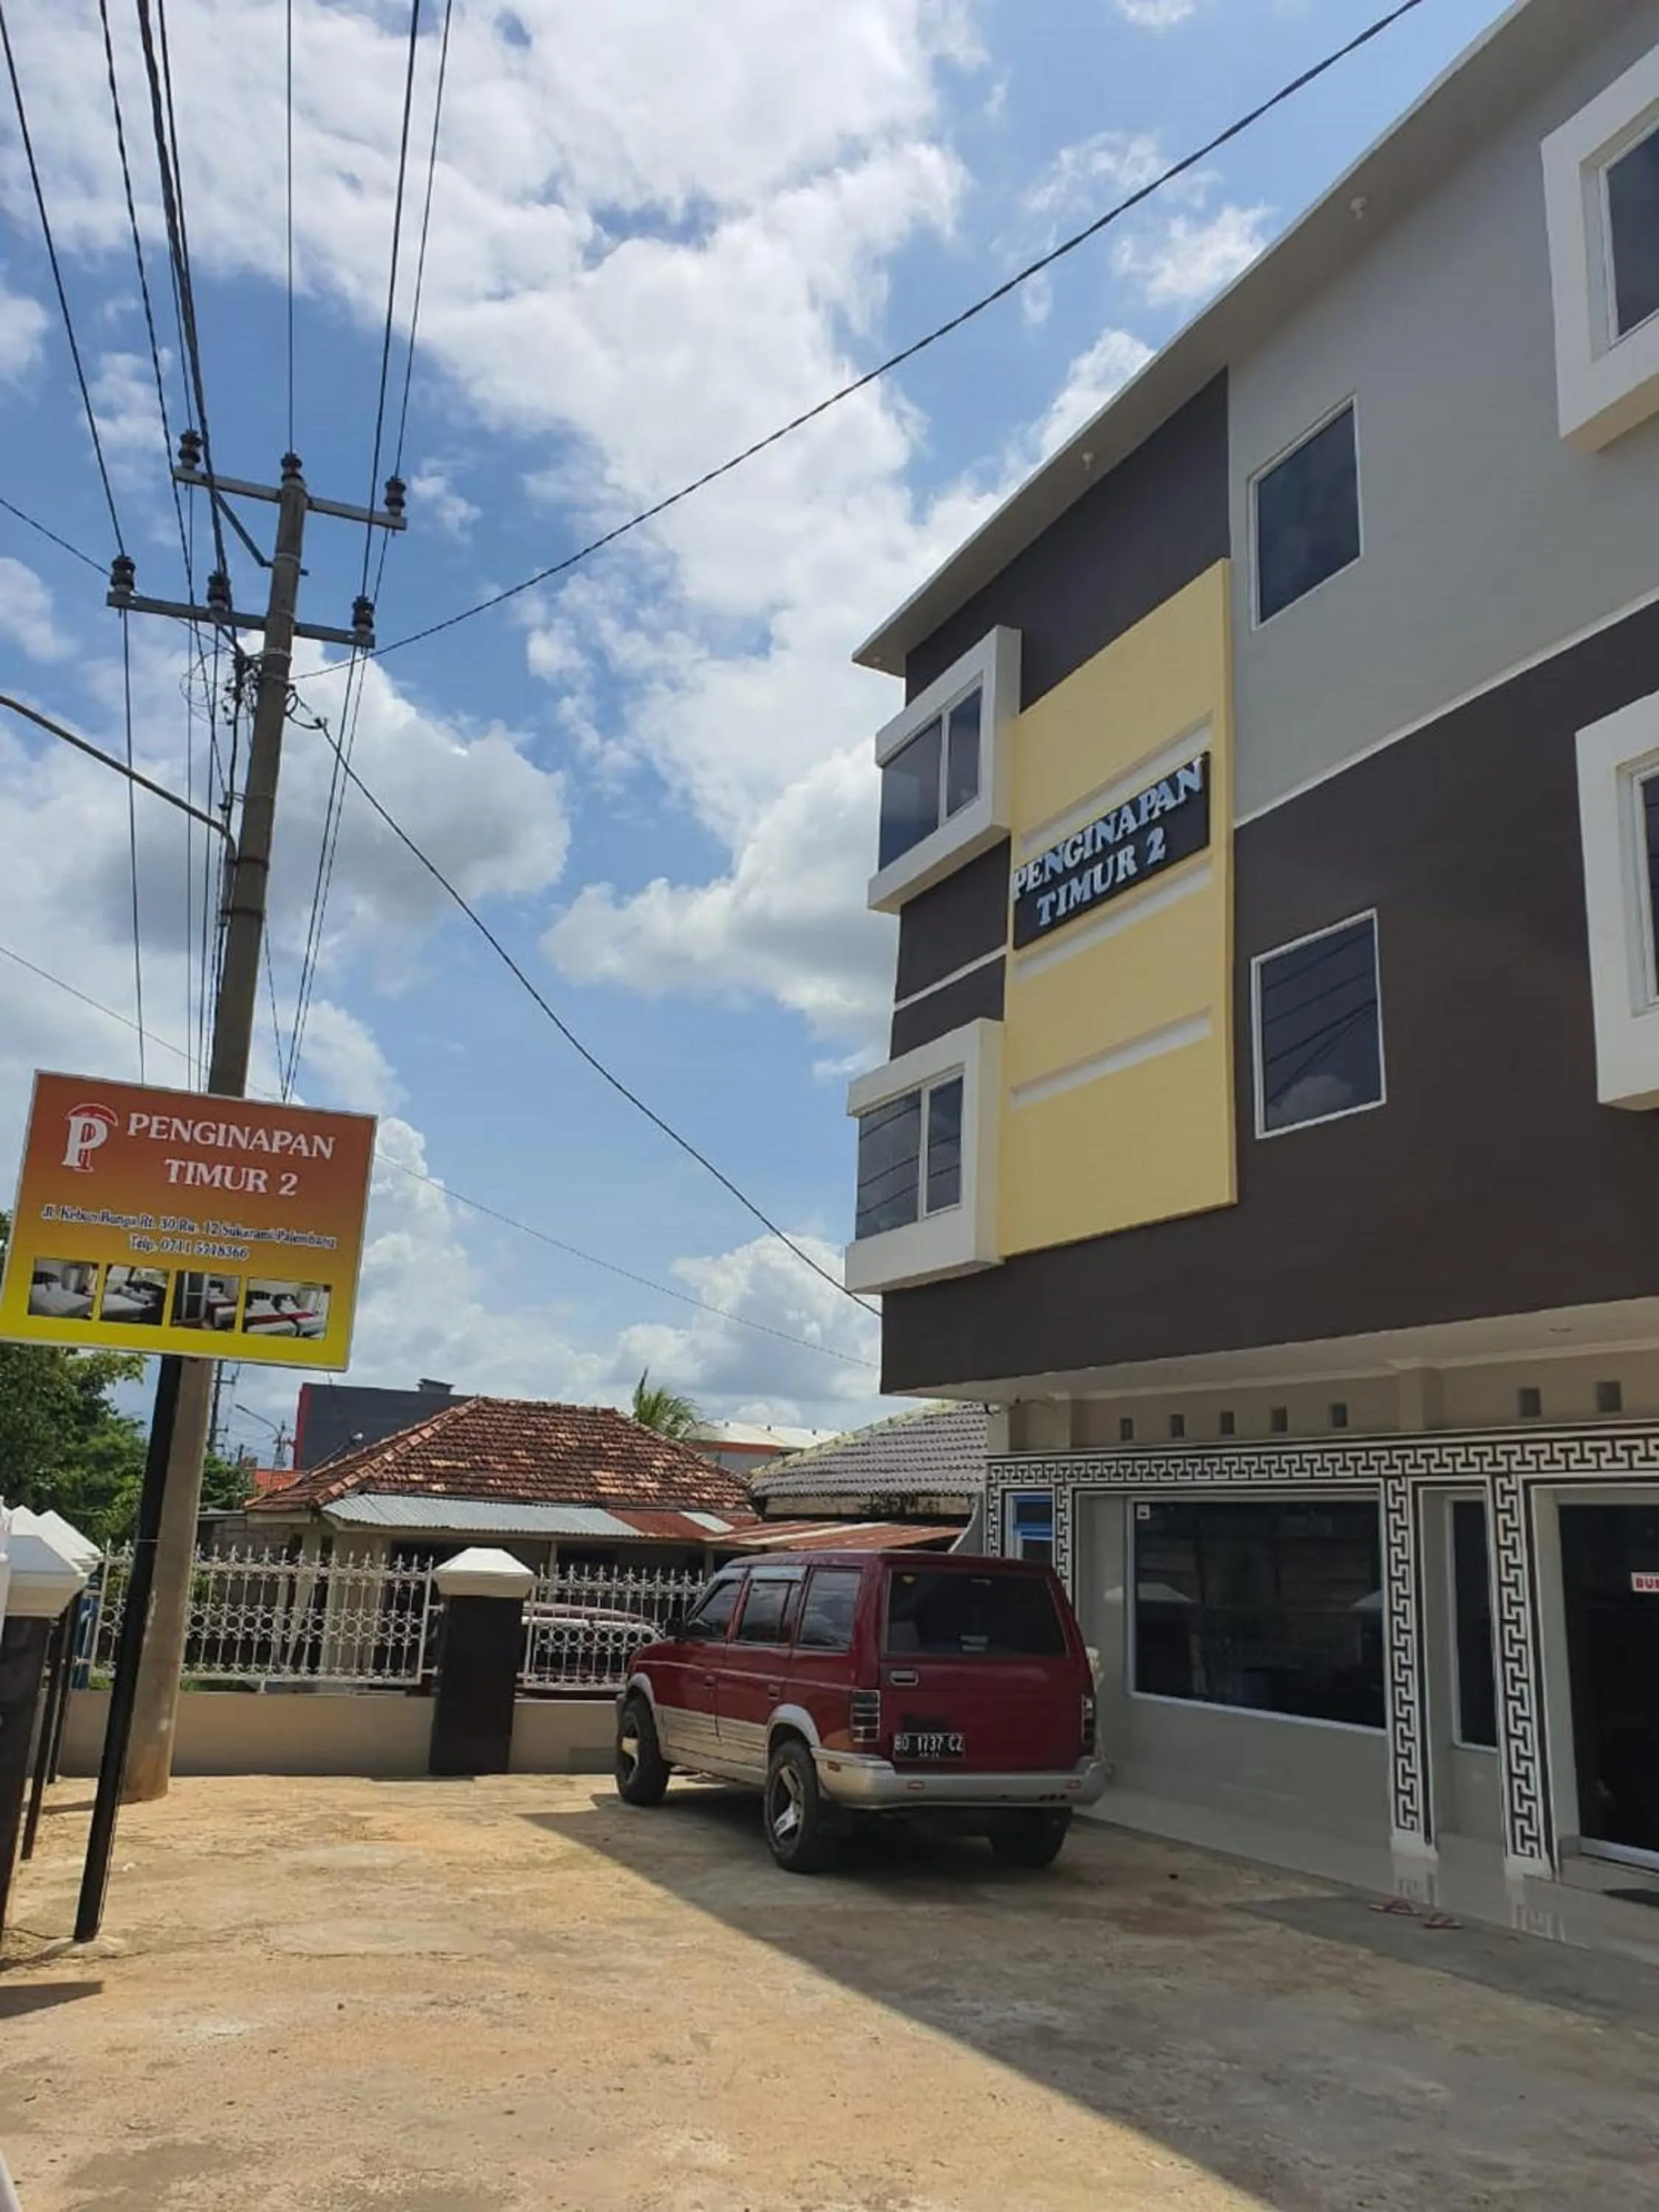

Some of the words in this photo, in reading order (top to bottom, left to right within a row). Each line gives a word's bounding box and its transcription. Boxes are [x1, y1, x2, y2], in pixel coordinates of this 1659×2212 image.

[1011, 757, 1203, 900] PENGINAPAN
[1037, 844, 1138, 926] TIMUR
[1146, 827, 1166, 865] 2
[127, 1112, 335, 1160] PENGINAPAN
[164, 1158, 268, 1194] TIMUR
[279, 1172, 298, 1196] 2
